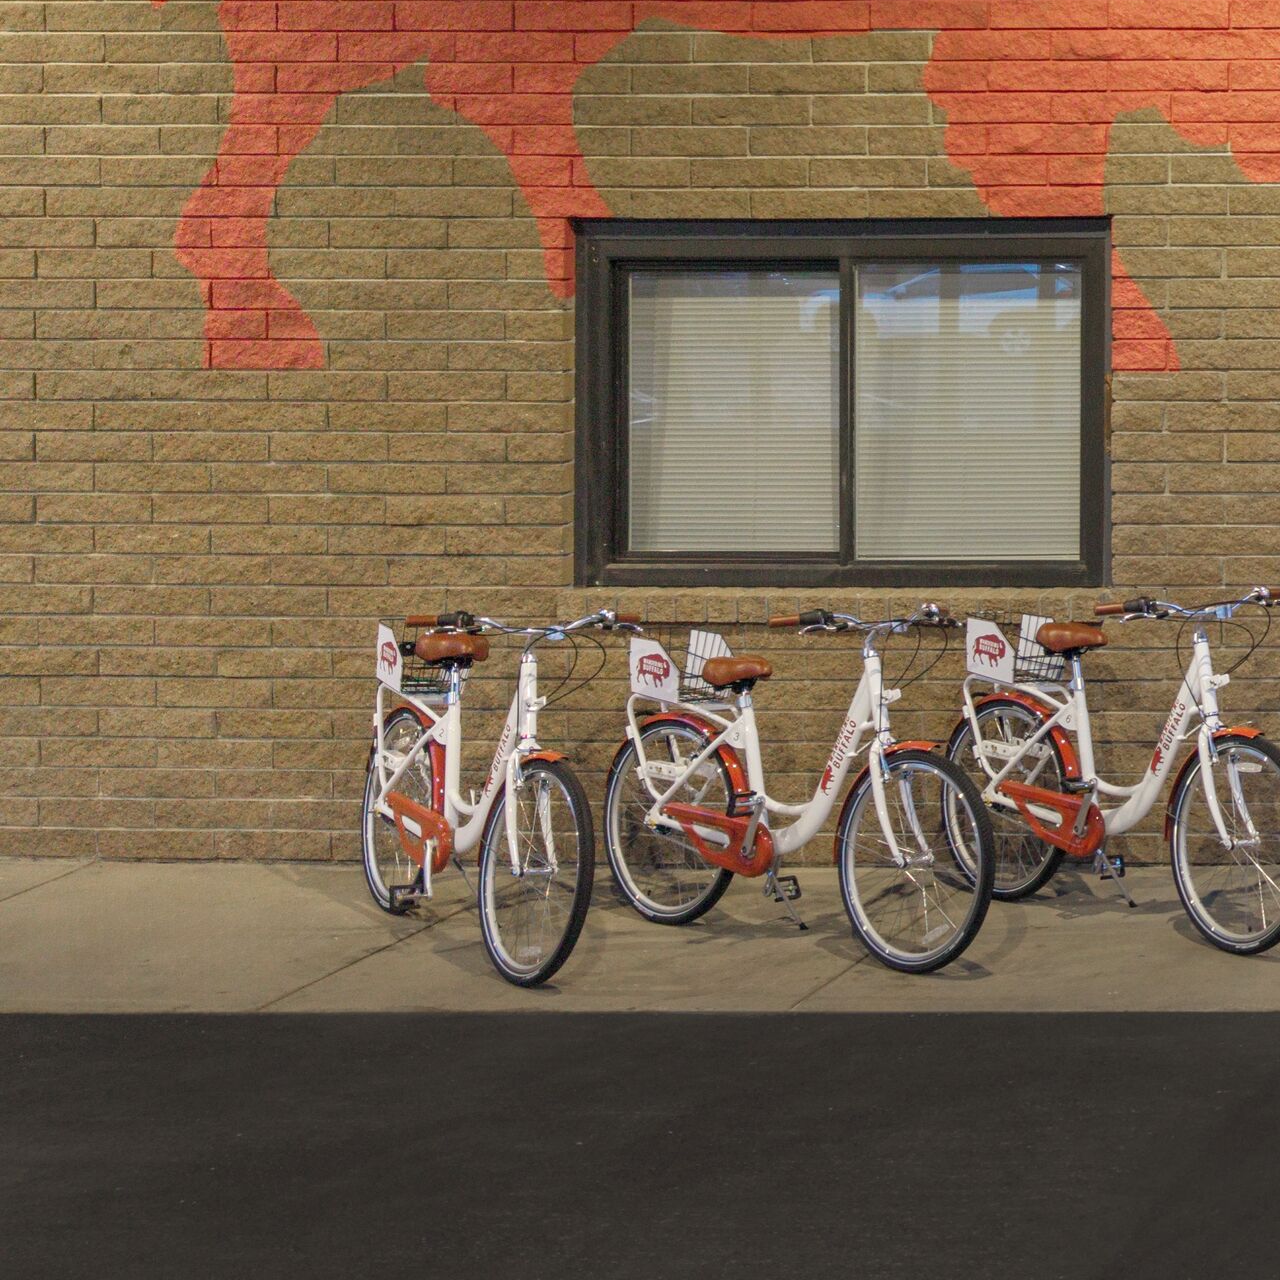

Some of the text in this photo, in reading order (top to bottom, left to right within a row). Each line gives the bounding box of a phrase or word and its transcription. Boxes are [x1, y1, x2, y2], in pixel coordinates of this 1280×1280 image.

[439, 728, 445, 738] 2
[1066, 714, 1072, 724] 6
[1162, 703, 1186, 751] BUFFALO
[493, 724, 511, 772] BUFFALO
[733, 731, 740, 741] 3
[833, 720, 857, 769] BUFFALO
